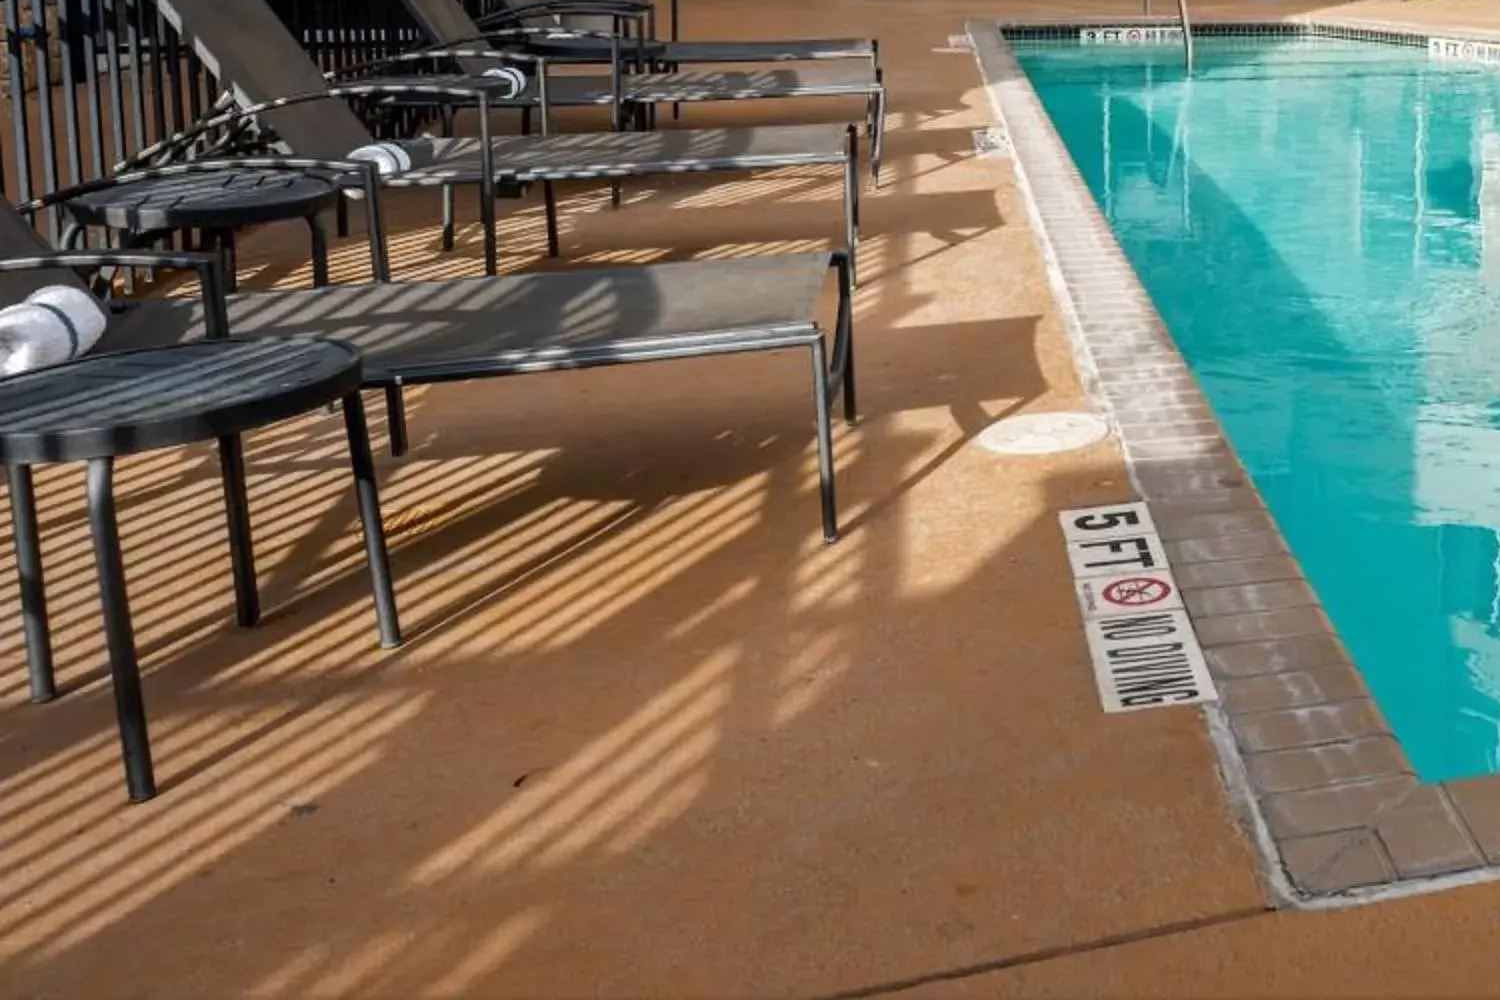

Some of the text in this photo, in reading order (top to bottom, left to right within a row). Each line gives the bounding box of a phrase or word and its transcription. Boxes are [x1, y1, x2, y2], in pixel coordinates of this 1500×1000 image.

[1445, 42, 1460, 56] FT
[1074, 510, 1200, 707] 5 FT NO DIVING
